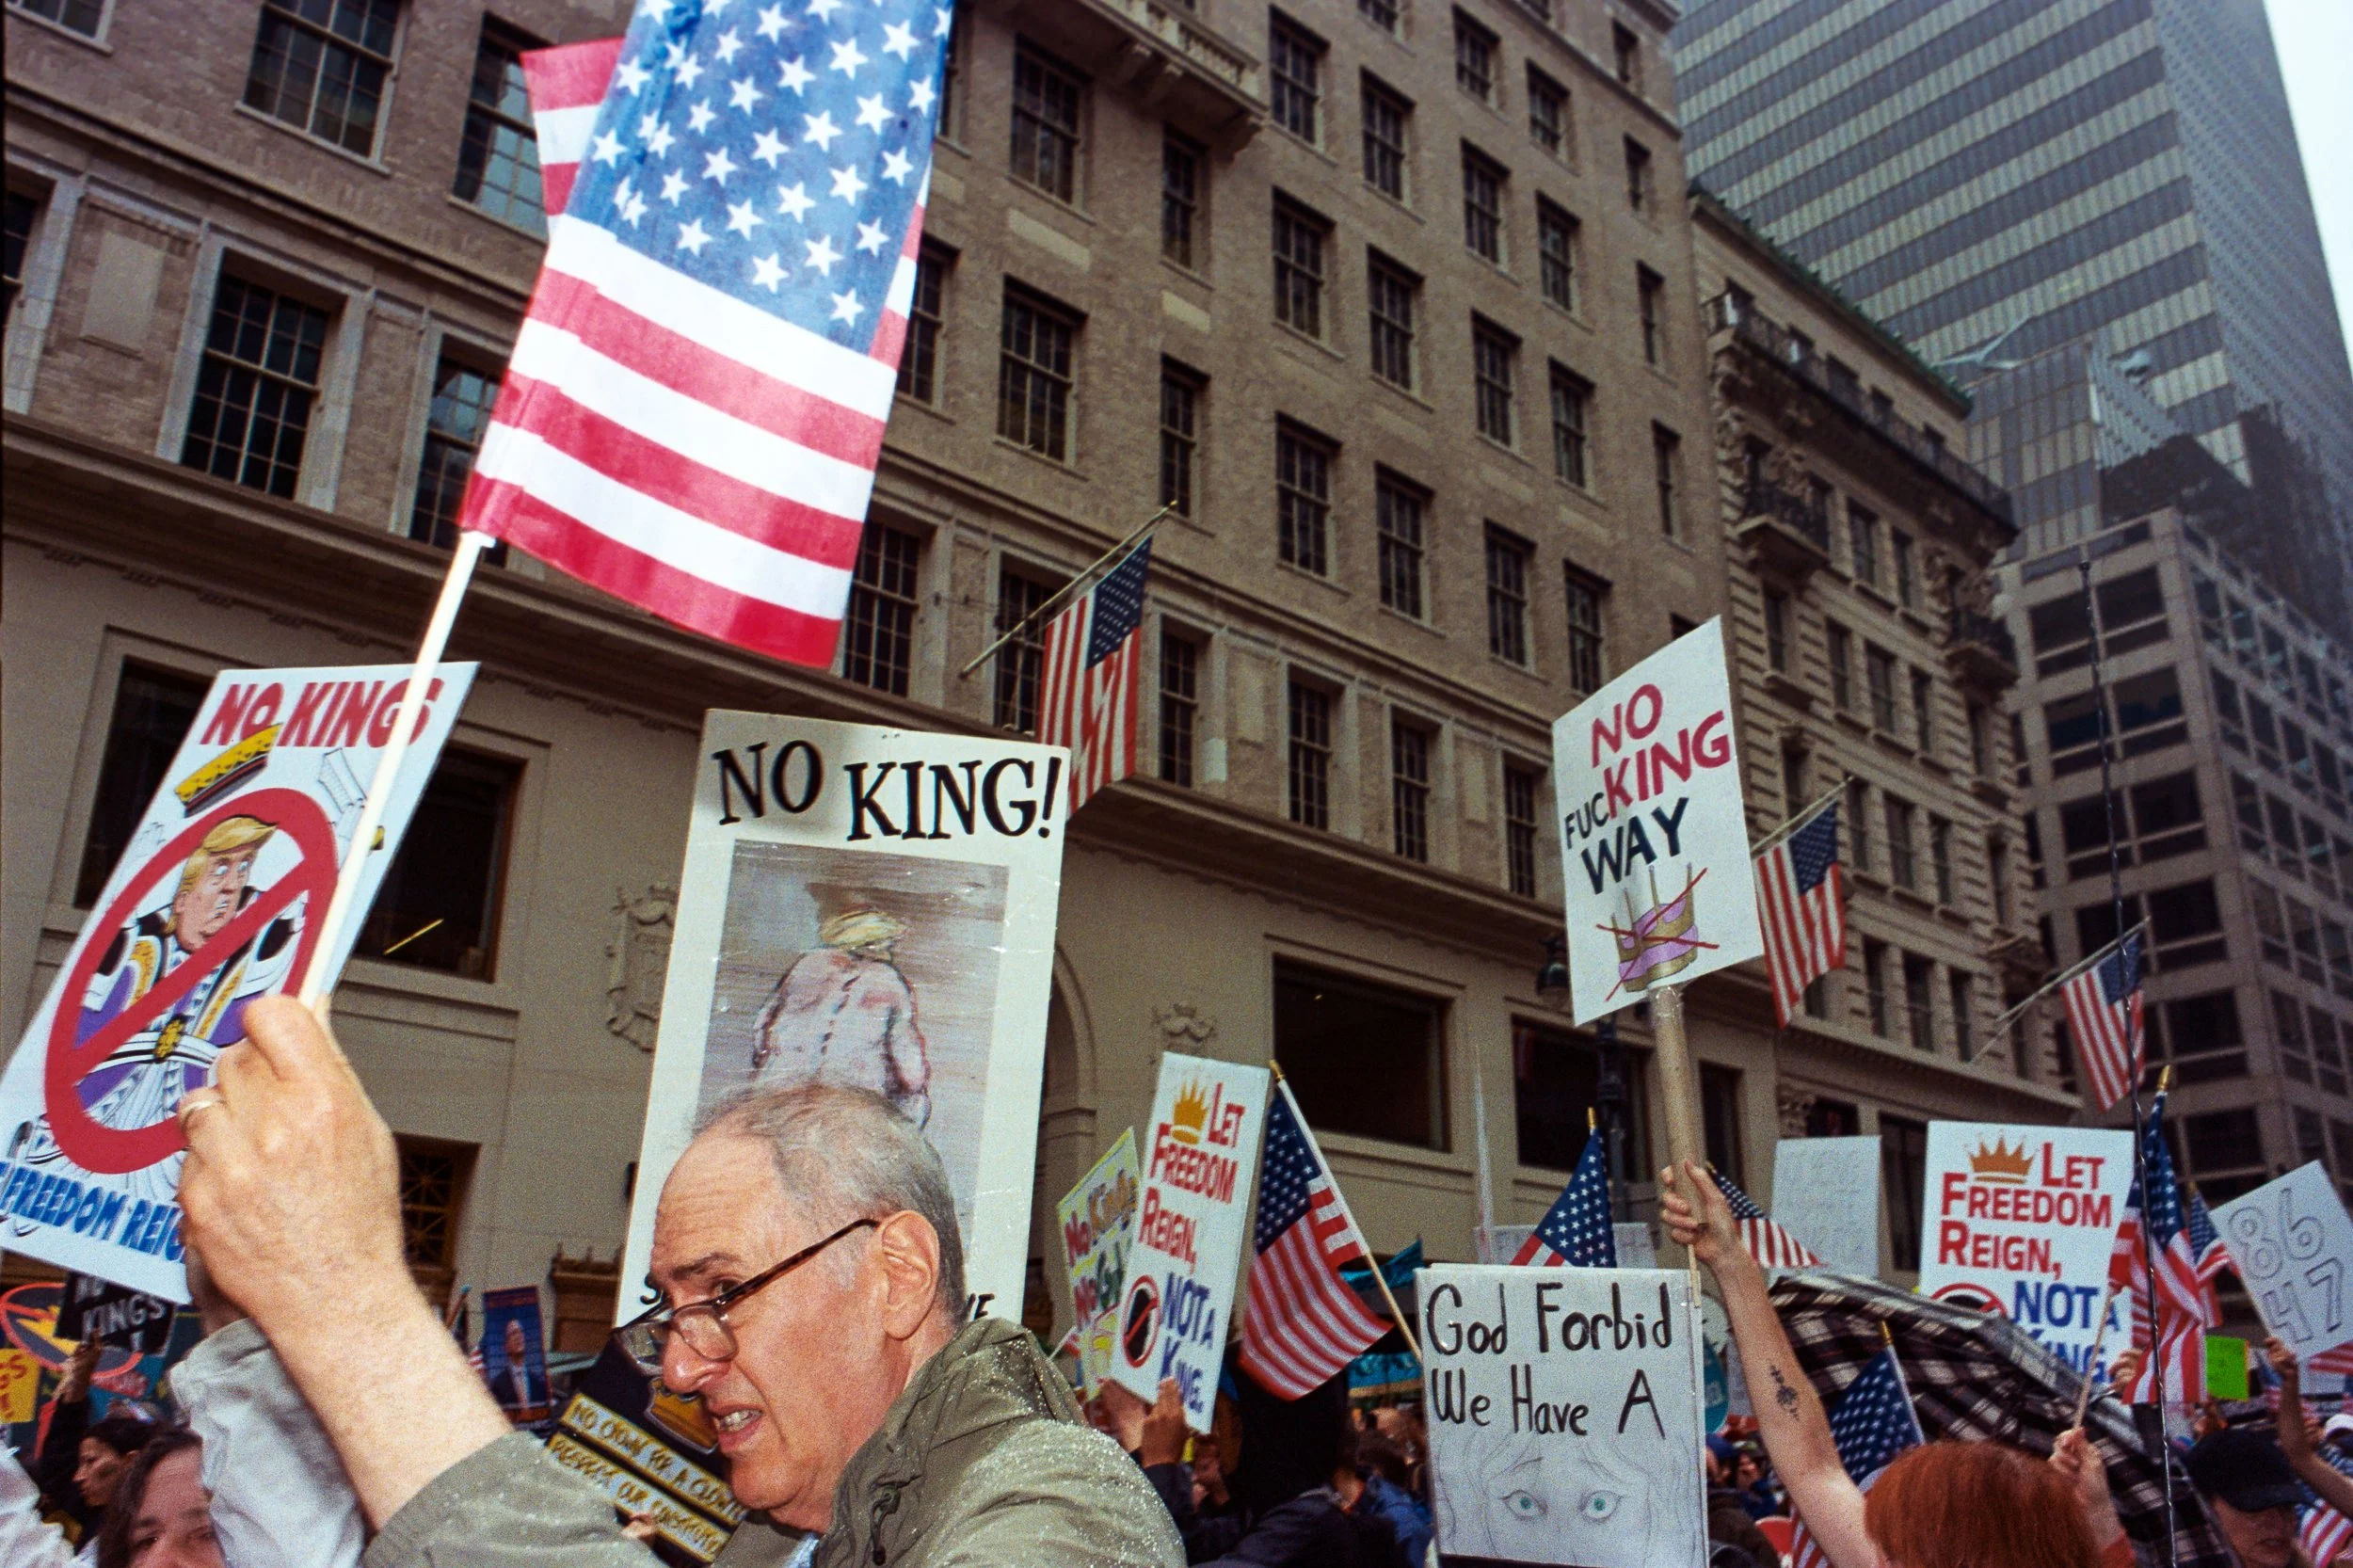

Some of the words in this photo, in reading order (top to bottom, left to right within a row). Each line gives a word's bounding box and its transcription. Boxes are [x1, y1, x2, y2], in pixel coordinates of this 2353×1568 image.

[199, 682, 284, 745] NO
[277, 678, 444, 748] KINGS
[1592, 683, 1664, 769] NO
[712, 739, 824, 825] NO
[842, 756, 1064, 843] KING!
[1580, 797, 1690, 895] WAY
[1208, 1081, 1246, 1148] LET
[1147, 1122, 1240, 1205] FREEDOM
[1940, 1171, 2113, 1229] FREEDOM
[2041, 1141, 2106, 1191] LET
[0, 1165, 129, 1240] FREEDOM
[2228, 1187, 2325, 1281] 86
[1938, 1218, 2063, 1281] REIGN,
[1159, 1272, 1210, 1343] NOT
[1199, 1307, 1216, 1351] A
[1426, 1283, 1508, 1356] God
[1536, 1282, 1673, 1353] Forbid
[2009, 1279, 2100, 1330] NOT
[2262, 1256, 2344, 1344] 47
[1431, 1368, 1491, 1427] We
[1511, 1364, 1589, 1436] Have
[1617, 1368, 1666, 1441] A
